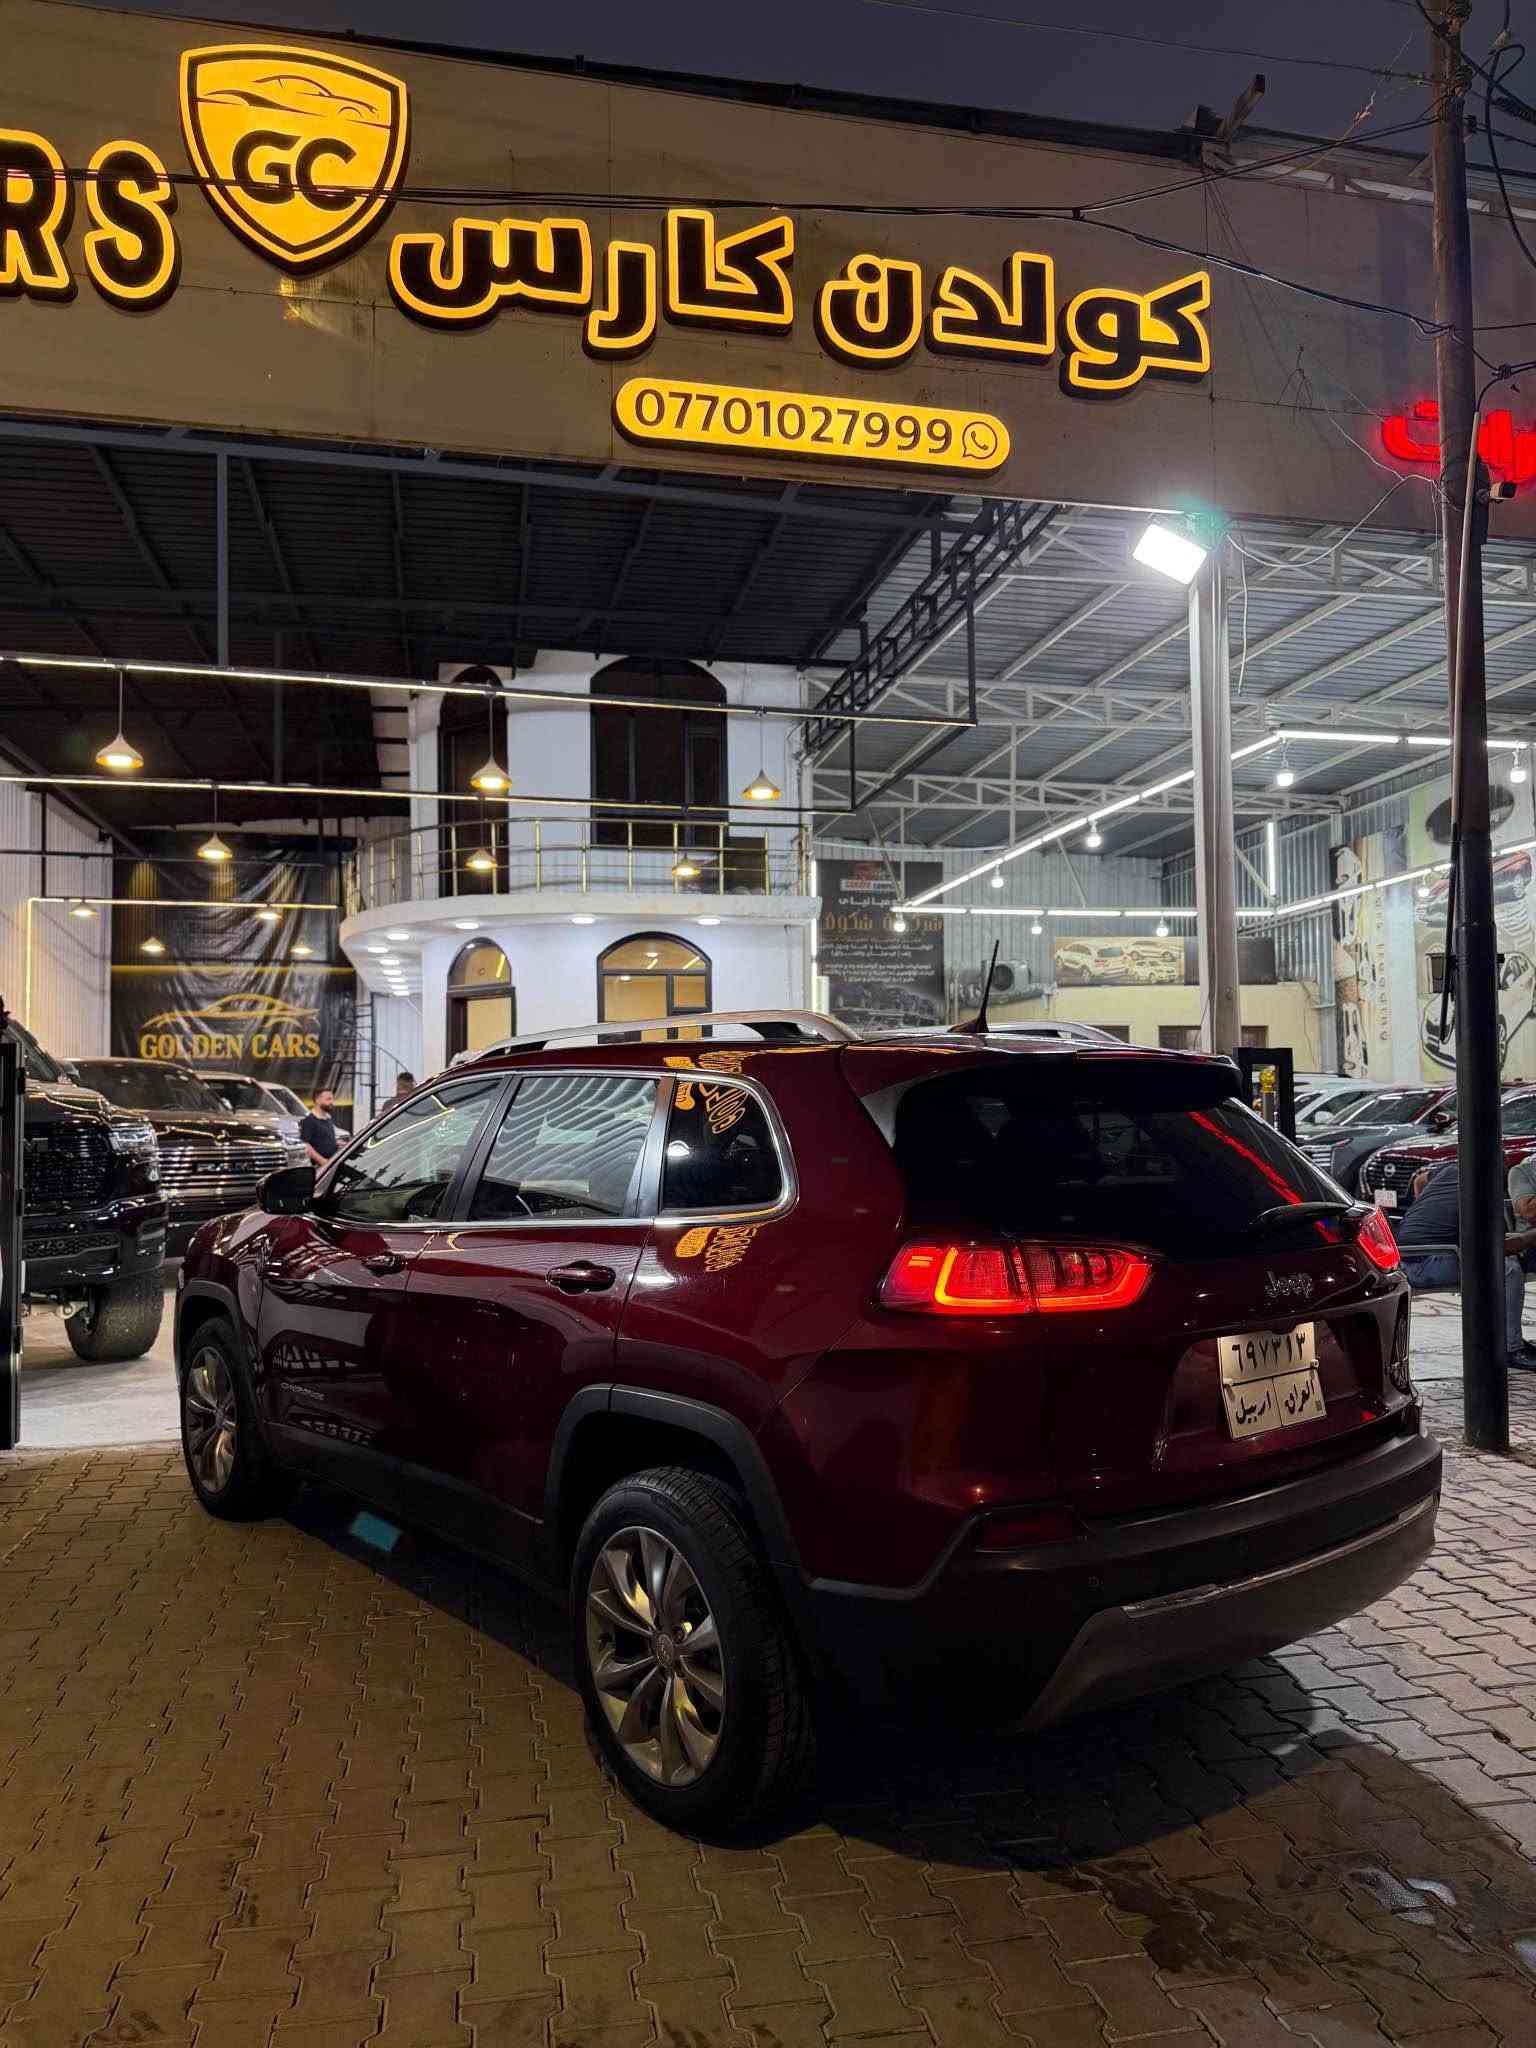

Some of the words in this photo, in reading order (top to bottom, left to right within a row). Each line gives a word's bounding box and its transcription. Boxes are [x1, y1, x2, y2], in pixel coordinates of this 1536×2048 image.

[232, 130, 357, 212] GC
[389, 209, 794, 350] كارس
[820, 251, 1212, 392] كولدن
[634, 388, 953, 454] 07701027999
[140, 1033, 244, 1059] GOLDEN
[251, 1033, 321, 1058] CARS
